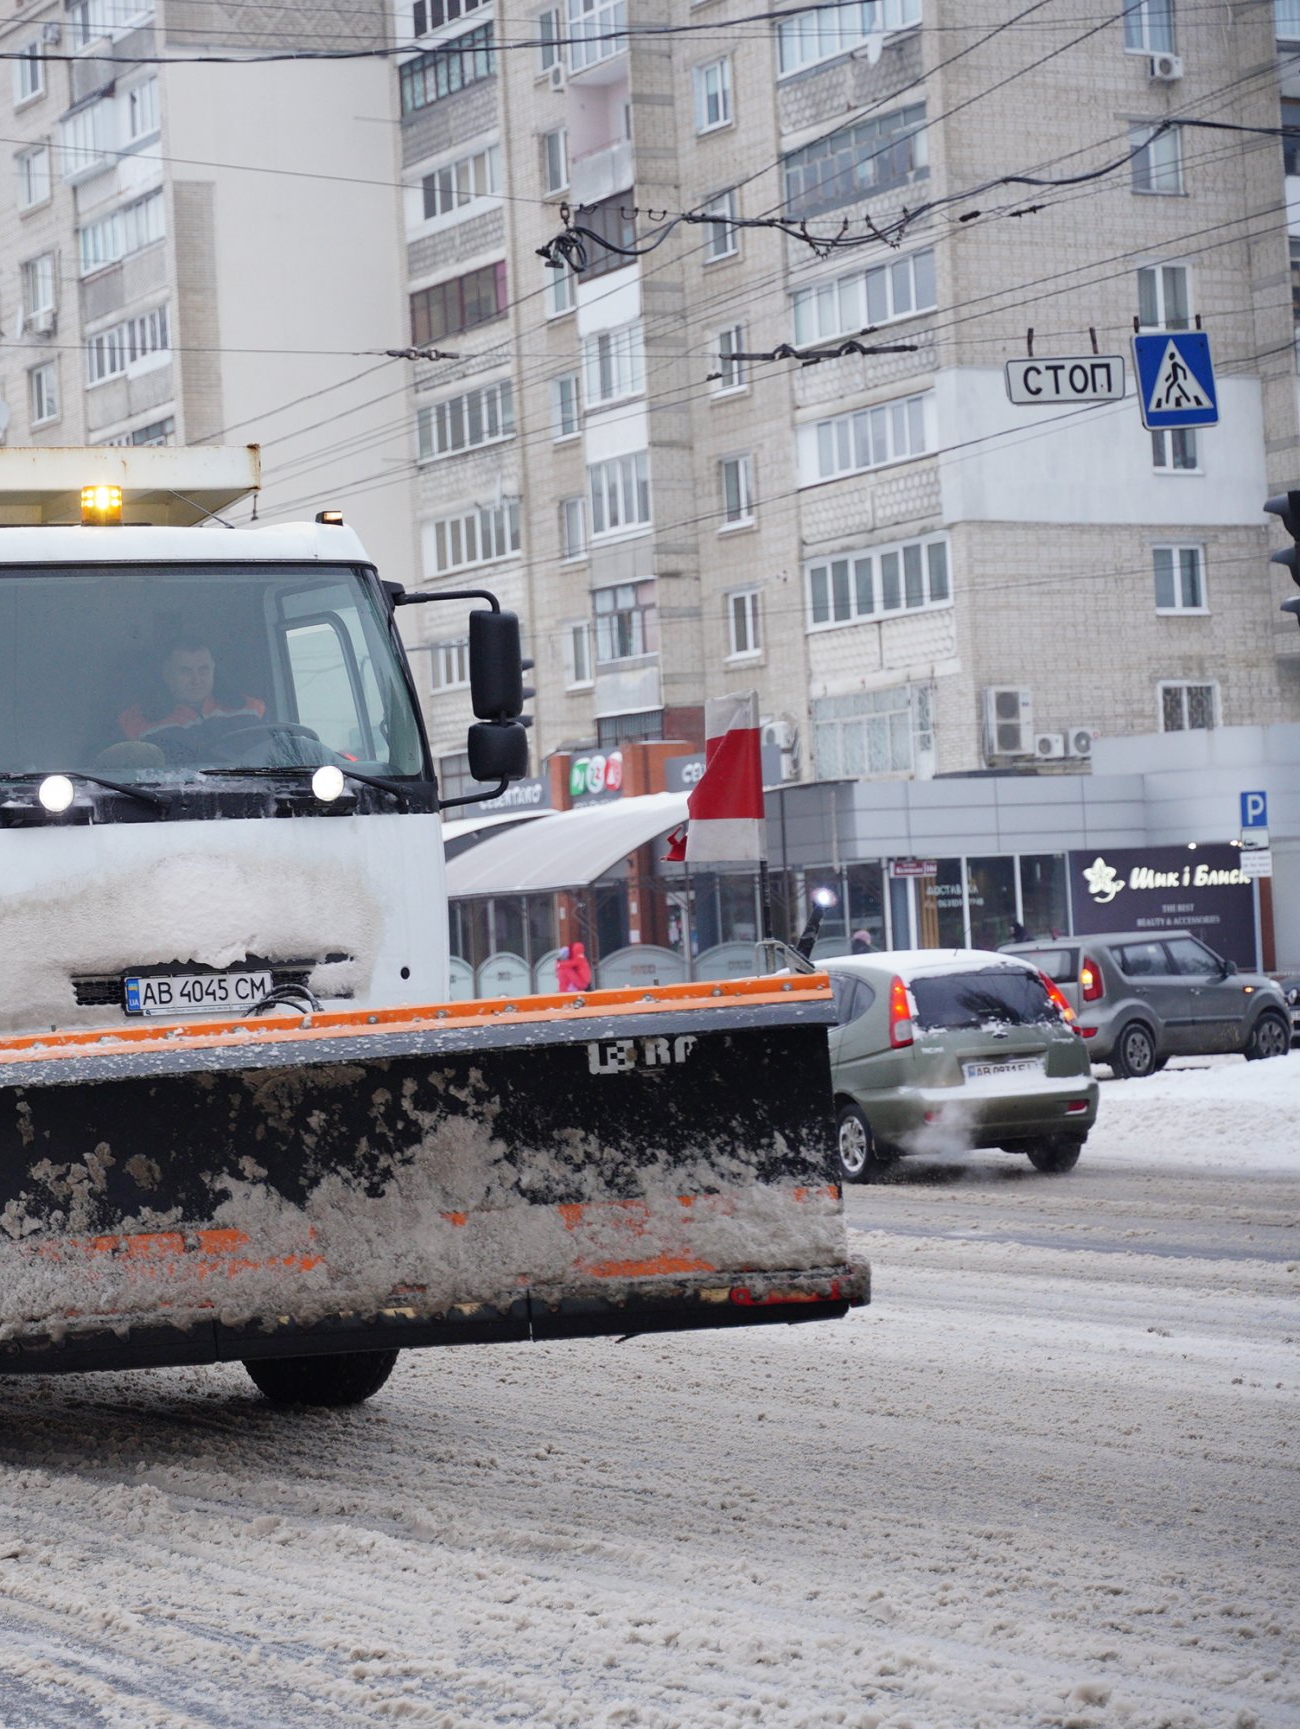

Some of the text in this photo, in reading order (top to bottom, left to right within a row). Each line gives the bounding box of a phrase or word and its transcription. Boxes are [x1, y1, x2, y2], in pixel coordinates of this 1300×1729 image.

[1023, 362, 1113, 396] СТОП
[1247, 794, 1265, 825] P
[1129, 867, 1180, 889] Шик
[143, 976, 267, 1006] AB 4045 CM
